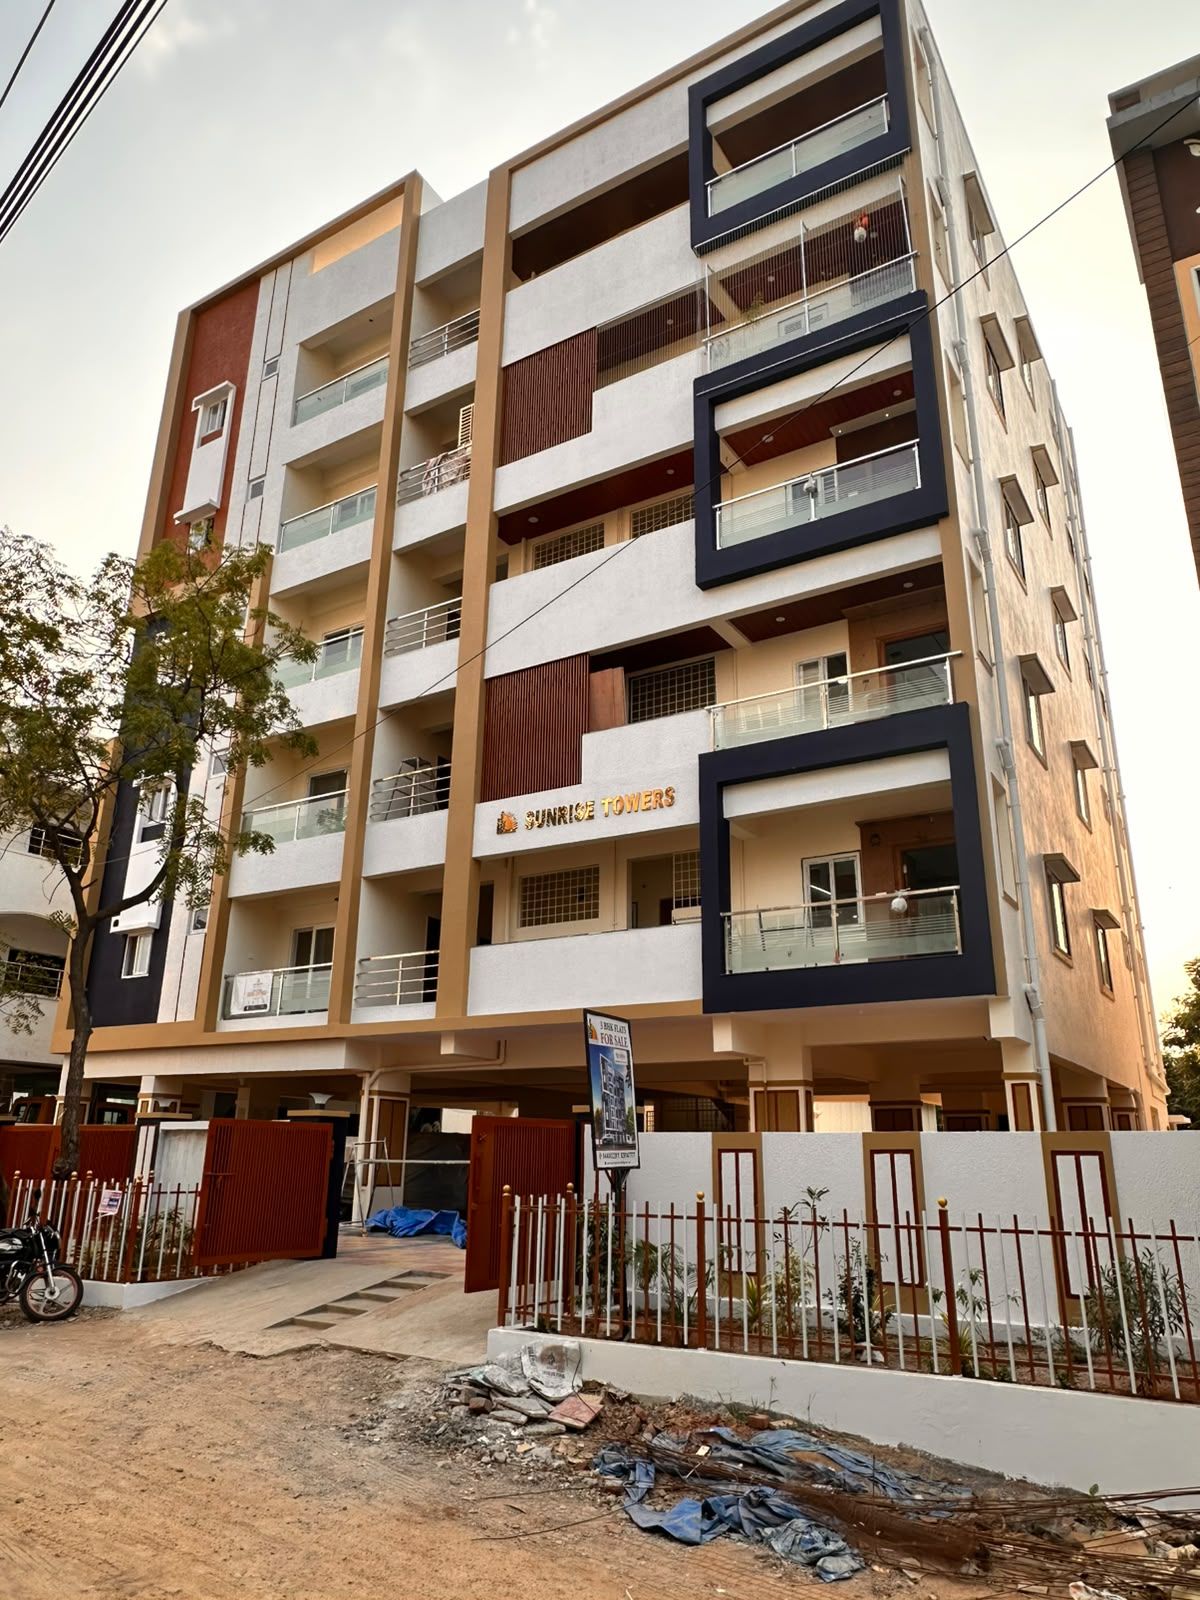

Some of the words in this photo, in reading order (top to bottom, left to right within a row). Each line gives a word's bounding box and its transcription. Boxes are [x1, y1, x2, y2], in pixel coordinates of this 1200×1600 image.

[524, 801, 595, 830] SUNRISE
[601, 786, 676, 818] TOWERS
[603, 1022, 613, 1031] BHK
[614, 1024, 627, 1034] FLATS
[600, 1033, 613, 1045] FOR
[614, 1035, 629, 1048] SALE
